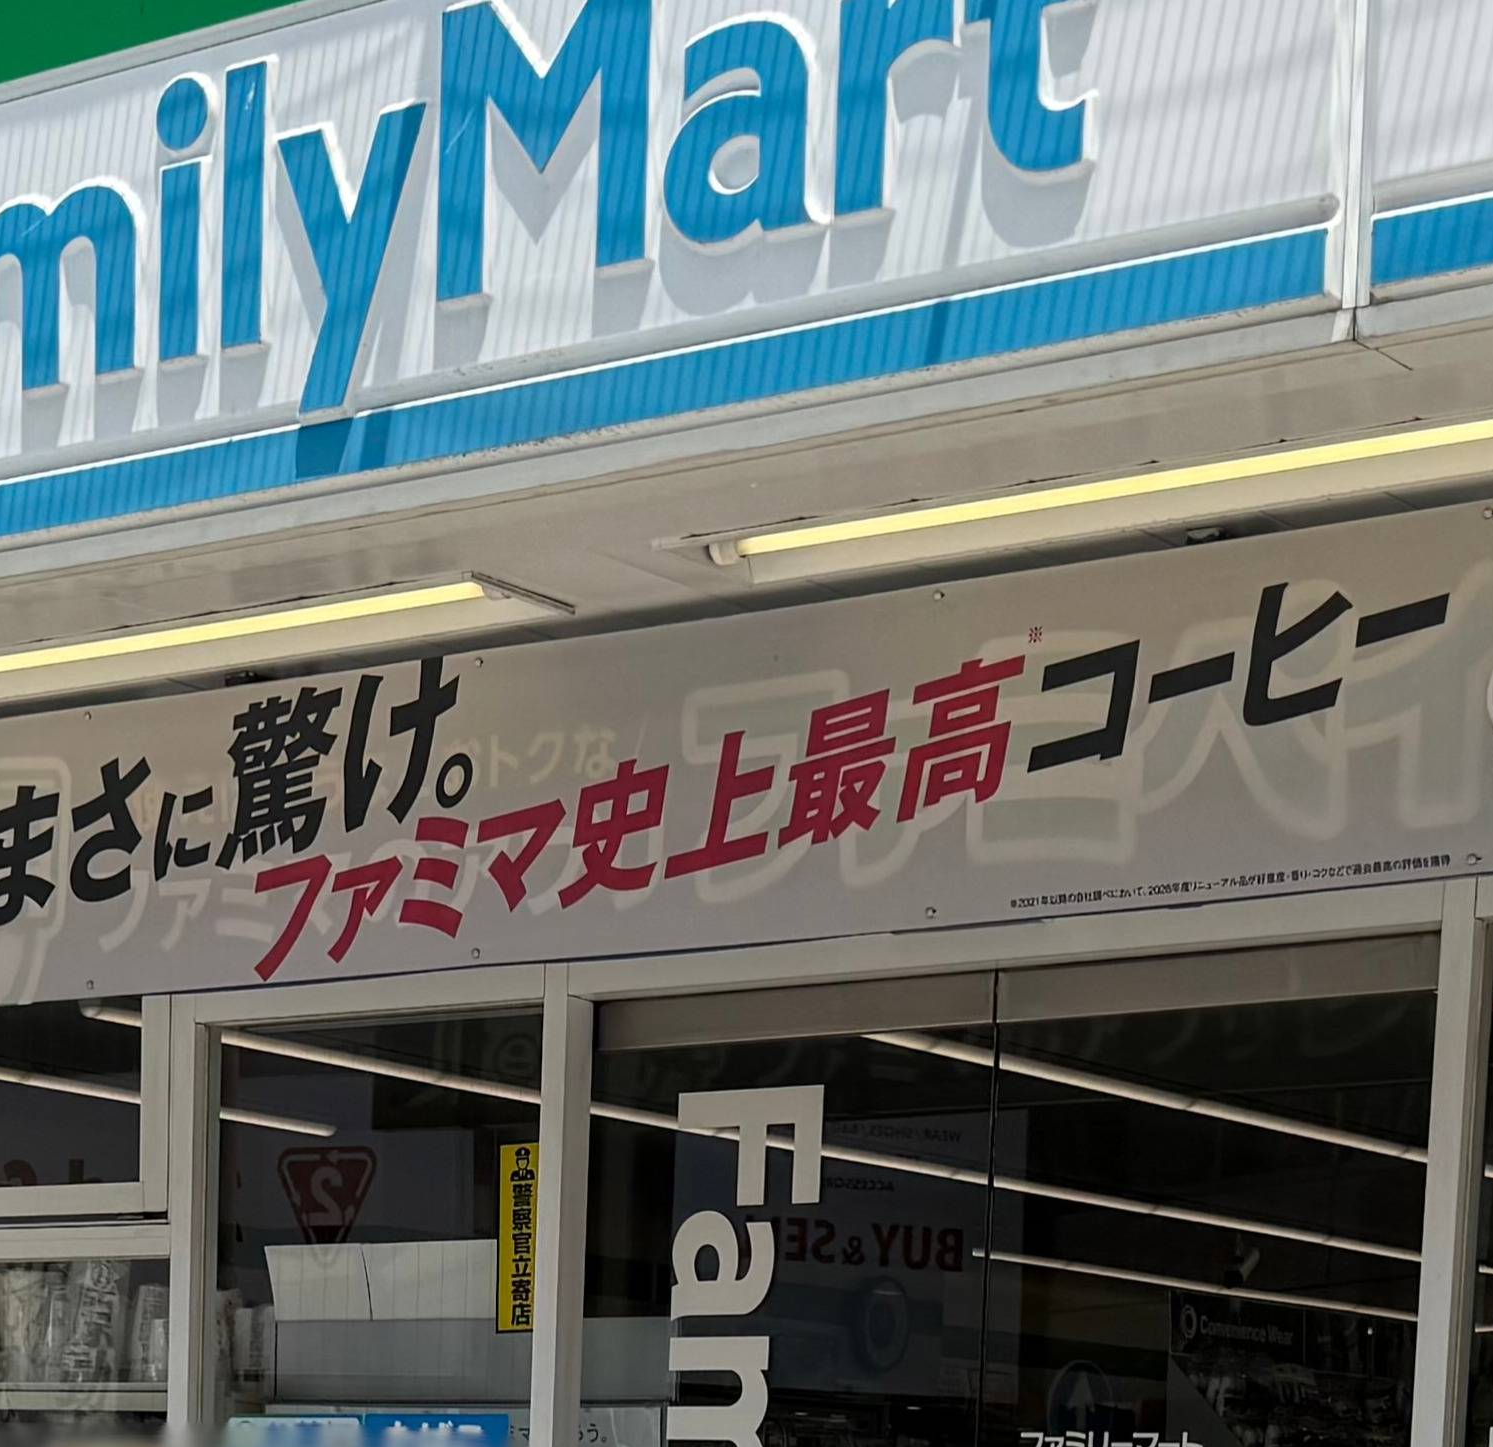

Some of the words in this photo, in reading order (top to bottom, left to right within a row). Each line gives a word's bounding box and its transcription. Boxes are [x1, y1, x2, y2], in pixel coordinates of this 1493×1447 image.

[509, 1182, 534, 1328] 警察官立寄店
